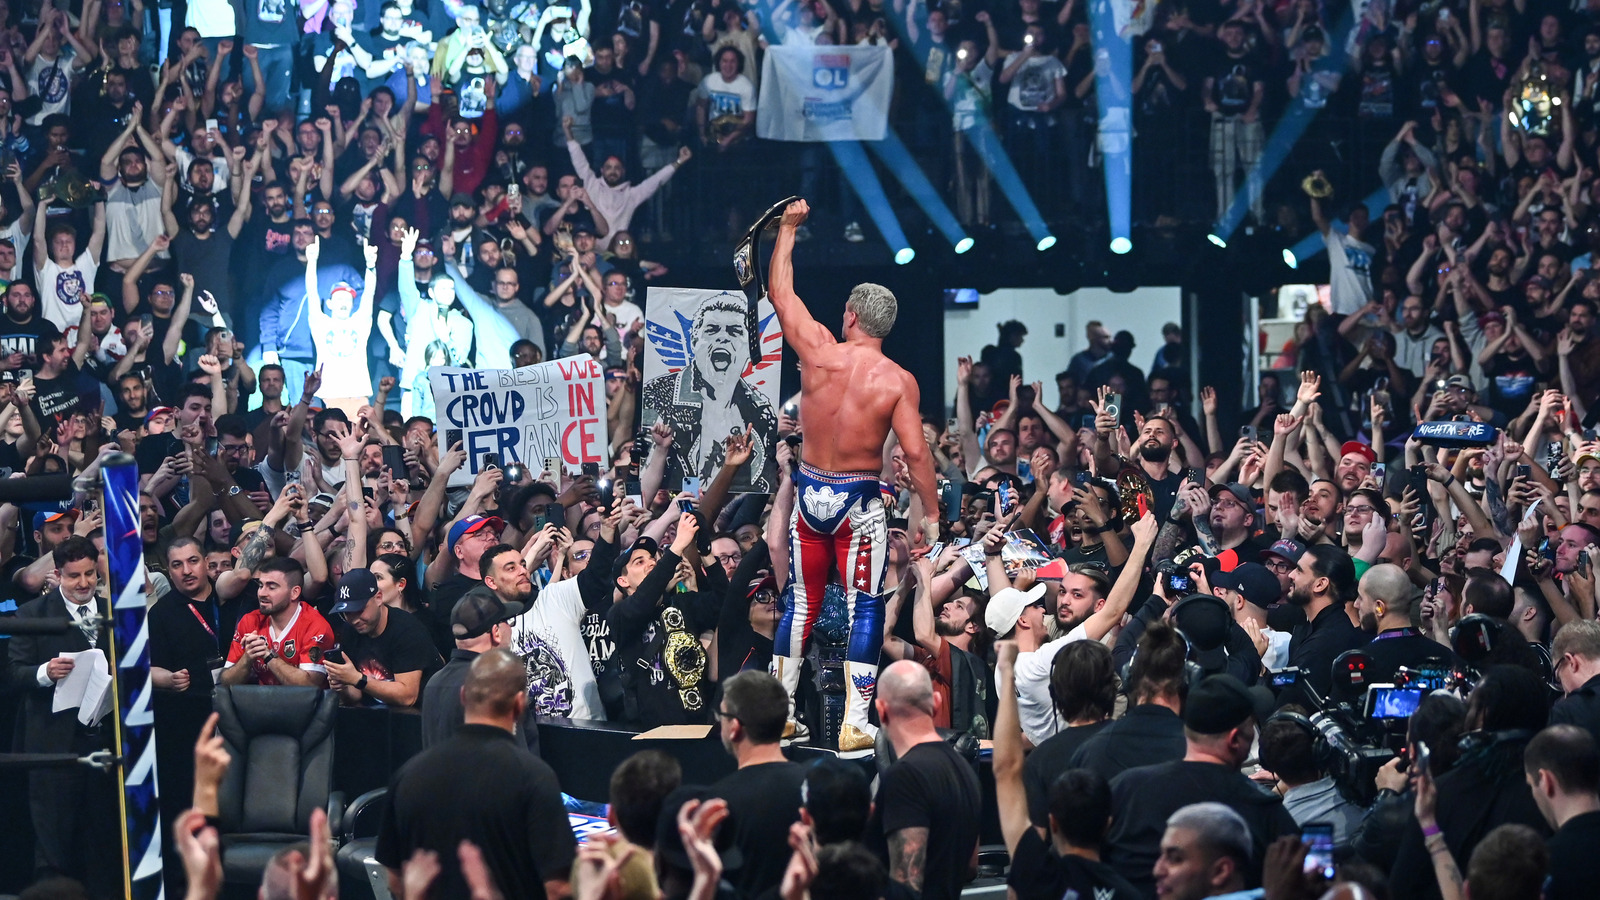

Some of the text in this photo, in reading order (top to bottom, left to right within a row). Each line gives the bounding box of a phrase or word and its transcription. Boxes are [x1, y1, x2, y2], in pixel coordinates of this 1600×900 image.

[815, 69, 845, 86] OL
[441, 359, 601, 392] THE BEST WWE
[446, 382, 595, 428] CROWD IS IN
[468, 418, 602, 475] FRANCE
[340, 585, 350, 599] NY
